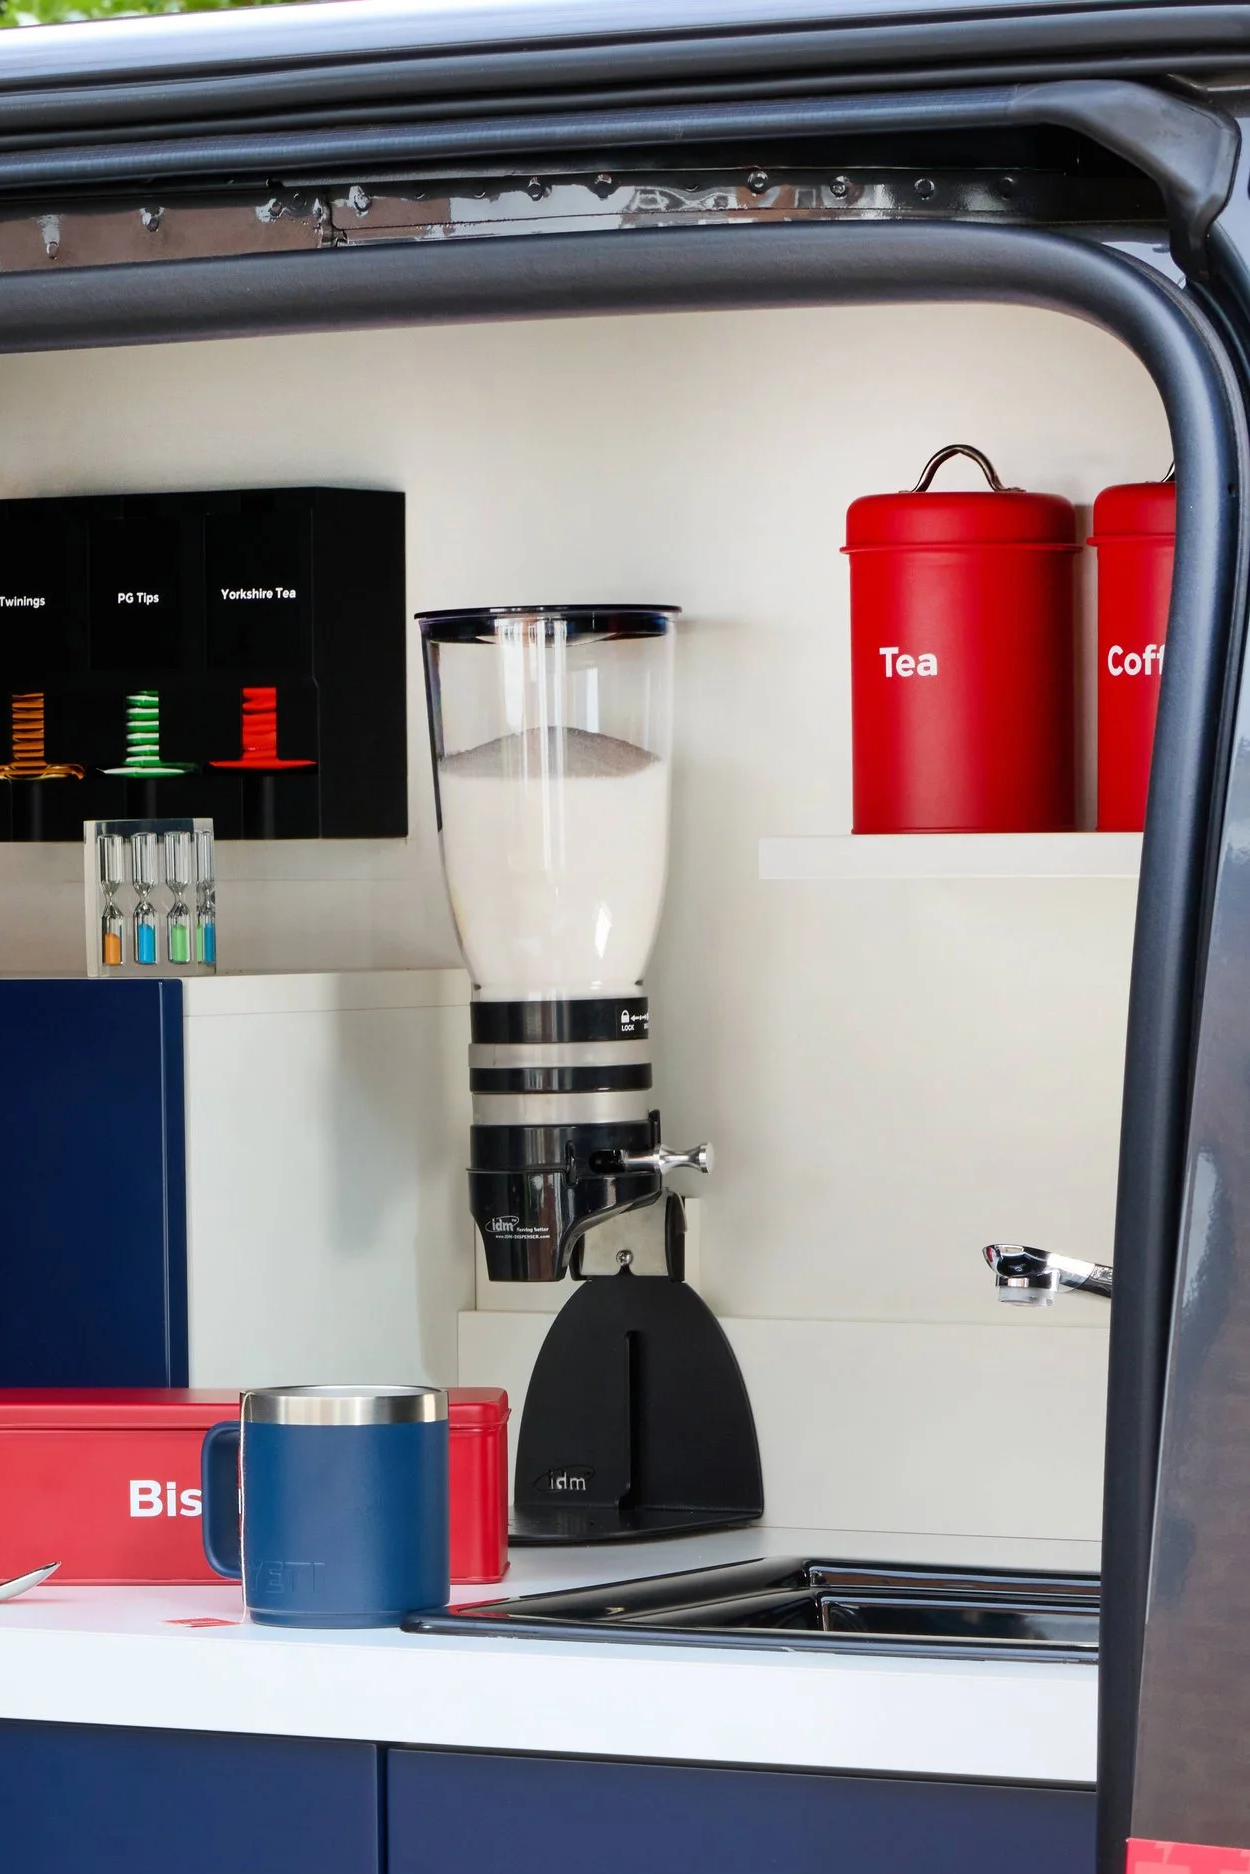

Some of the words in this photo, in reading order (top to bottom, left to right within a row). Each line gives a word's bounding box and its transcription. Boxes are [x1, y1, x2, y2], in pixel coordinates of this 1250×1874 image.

[117, 592, 134, 604] PG
[136, 592, 159, 606] Tips
[221, 587, 274, 600] Yorkshire
[275, 587, 297, 599] Tea
[879, 646, 938, 678] Tea
[621, 1024, 635, 1032] LOCK
[492, 1218, 514, 1232] idm
[550, 1471, 586, 1491] idm
